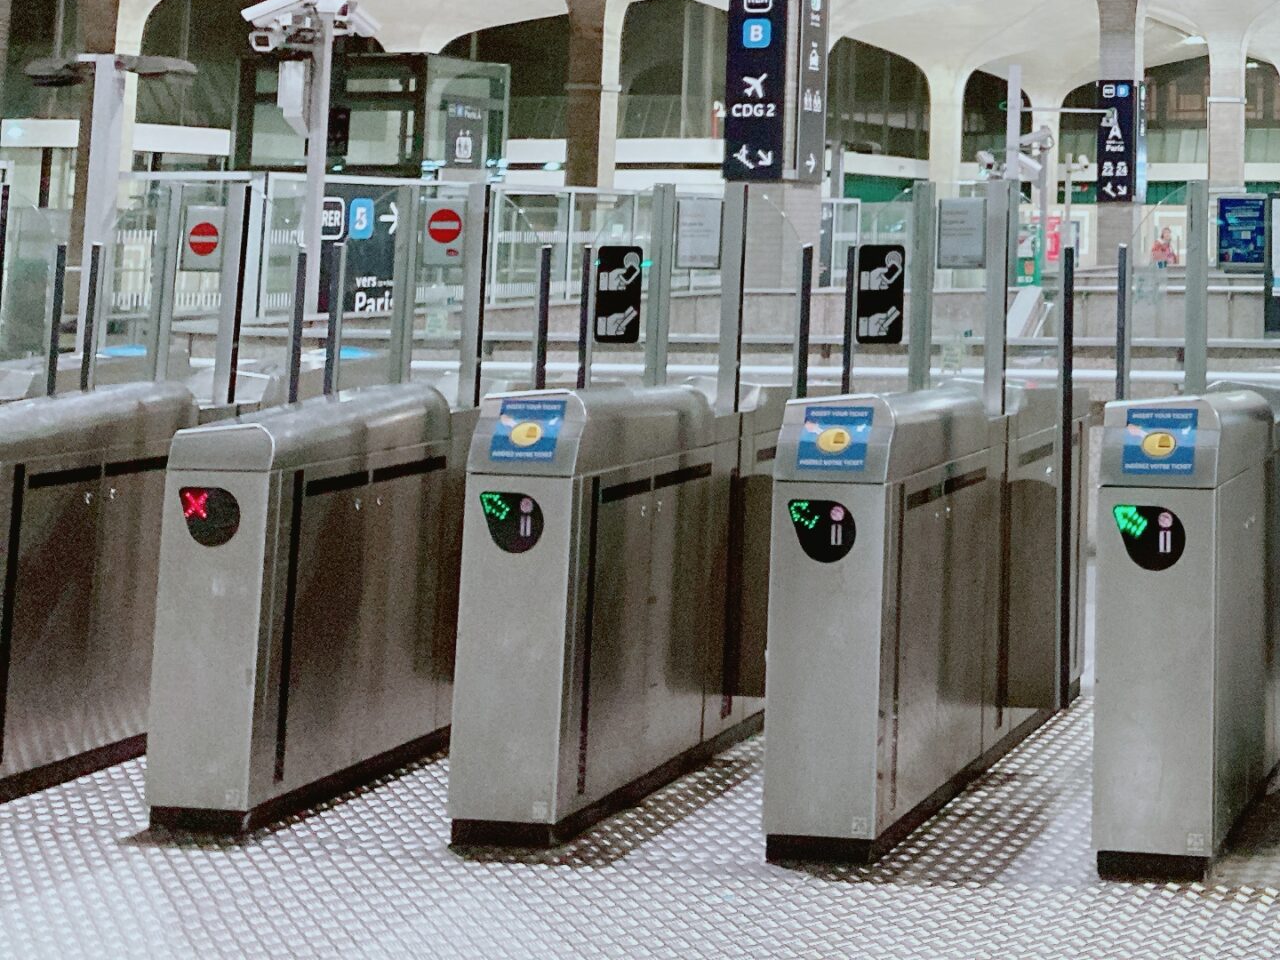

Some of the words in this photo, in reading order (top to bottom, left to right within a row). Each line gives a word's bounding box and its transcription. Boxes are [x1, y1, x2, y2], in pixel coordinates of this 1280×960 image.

[750, 25, 763, 42] B
[732, 104, 765, 118] CDG
[766, 104, 777, 117] 2
[321, 210, 341, 228] RER
[355, 276, 377, 288] vers
